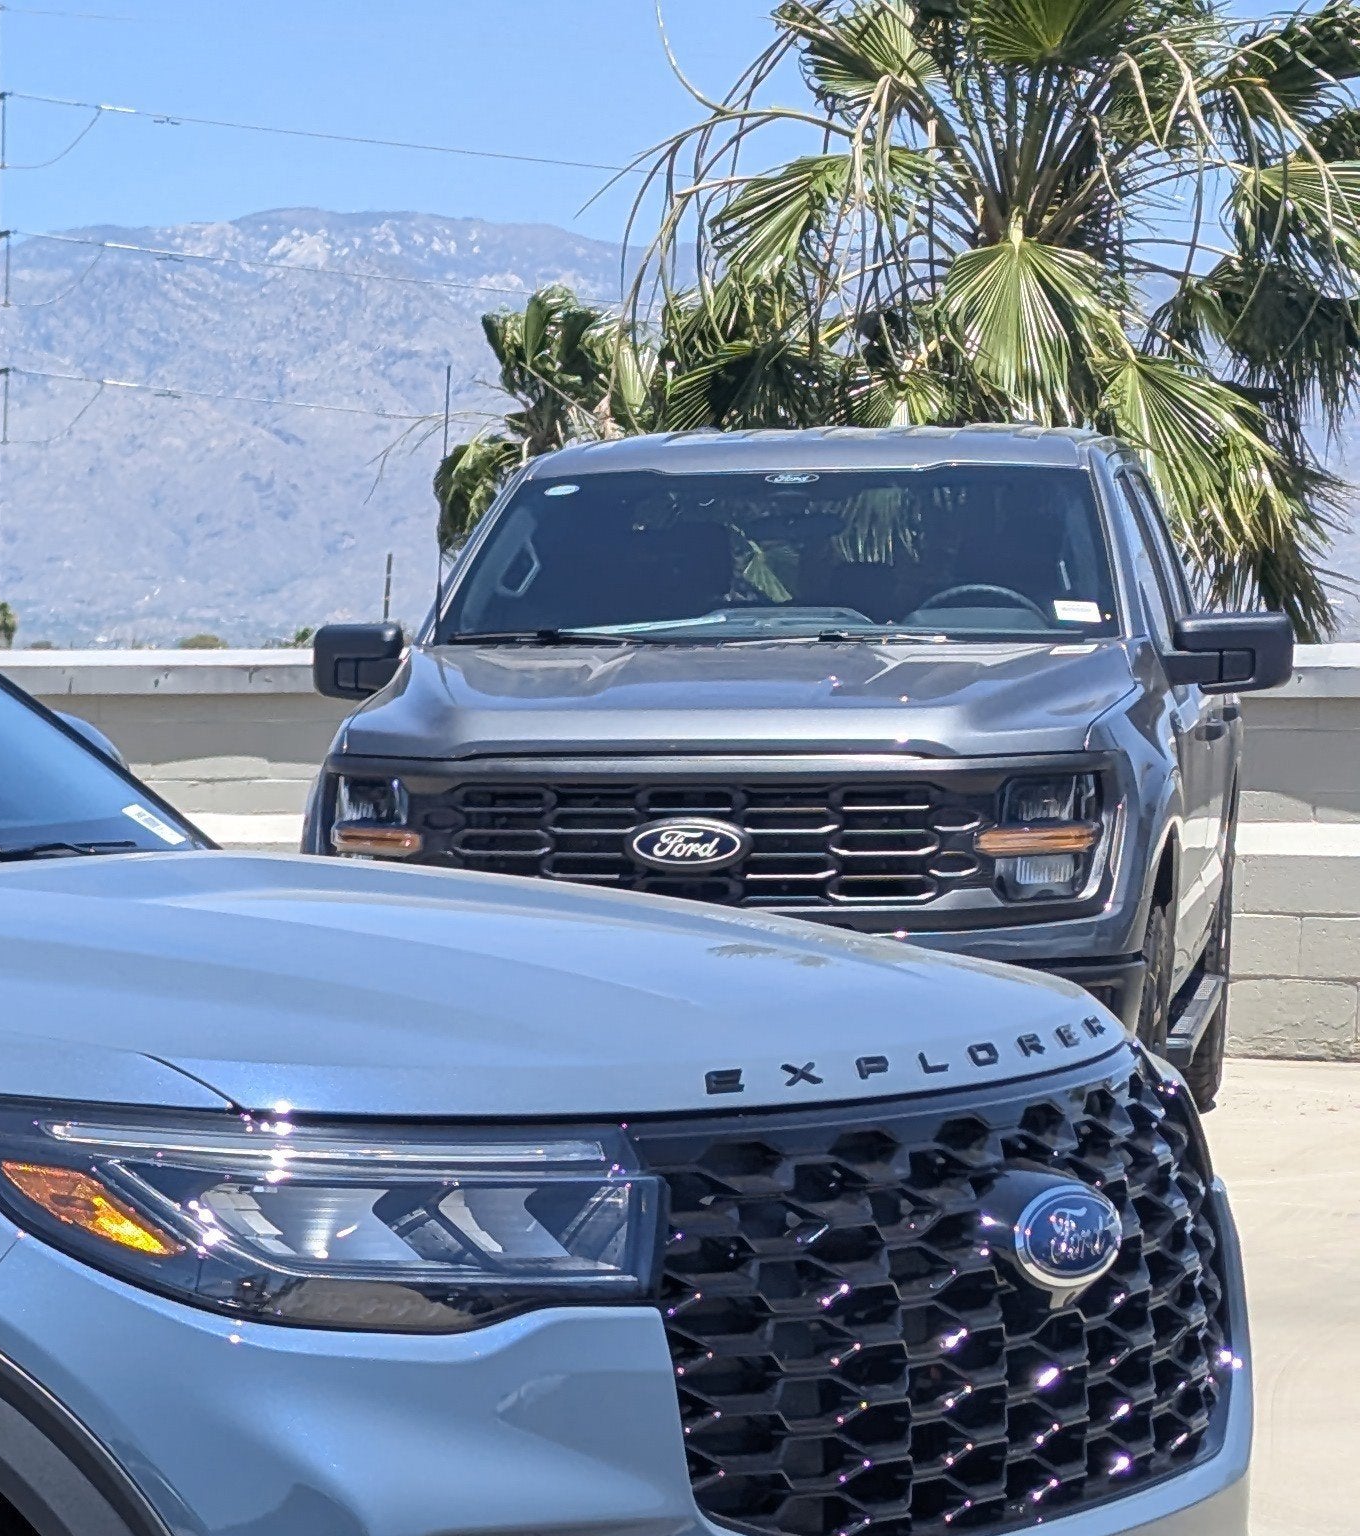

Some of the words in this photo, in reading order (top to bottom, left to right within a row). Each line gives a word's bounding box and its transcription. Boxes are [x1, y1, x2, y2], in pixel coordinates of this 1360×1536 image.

[652, 830, 720, 858] Ford
[704, 1014, 1107, 1095] EXPLORER
[1049, 1206, 1105, 1265] Ford
